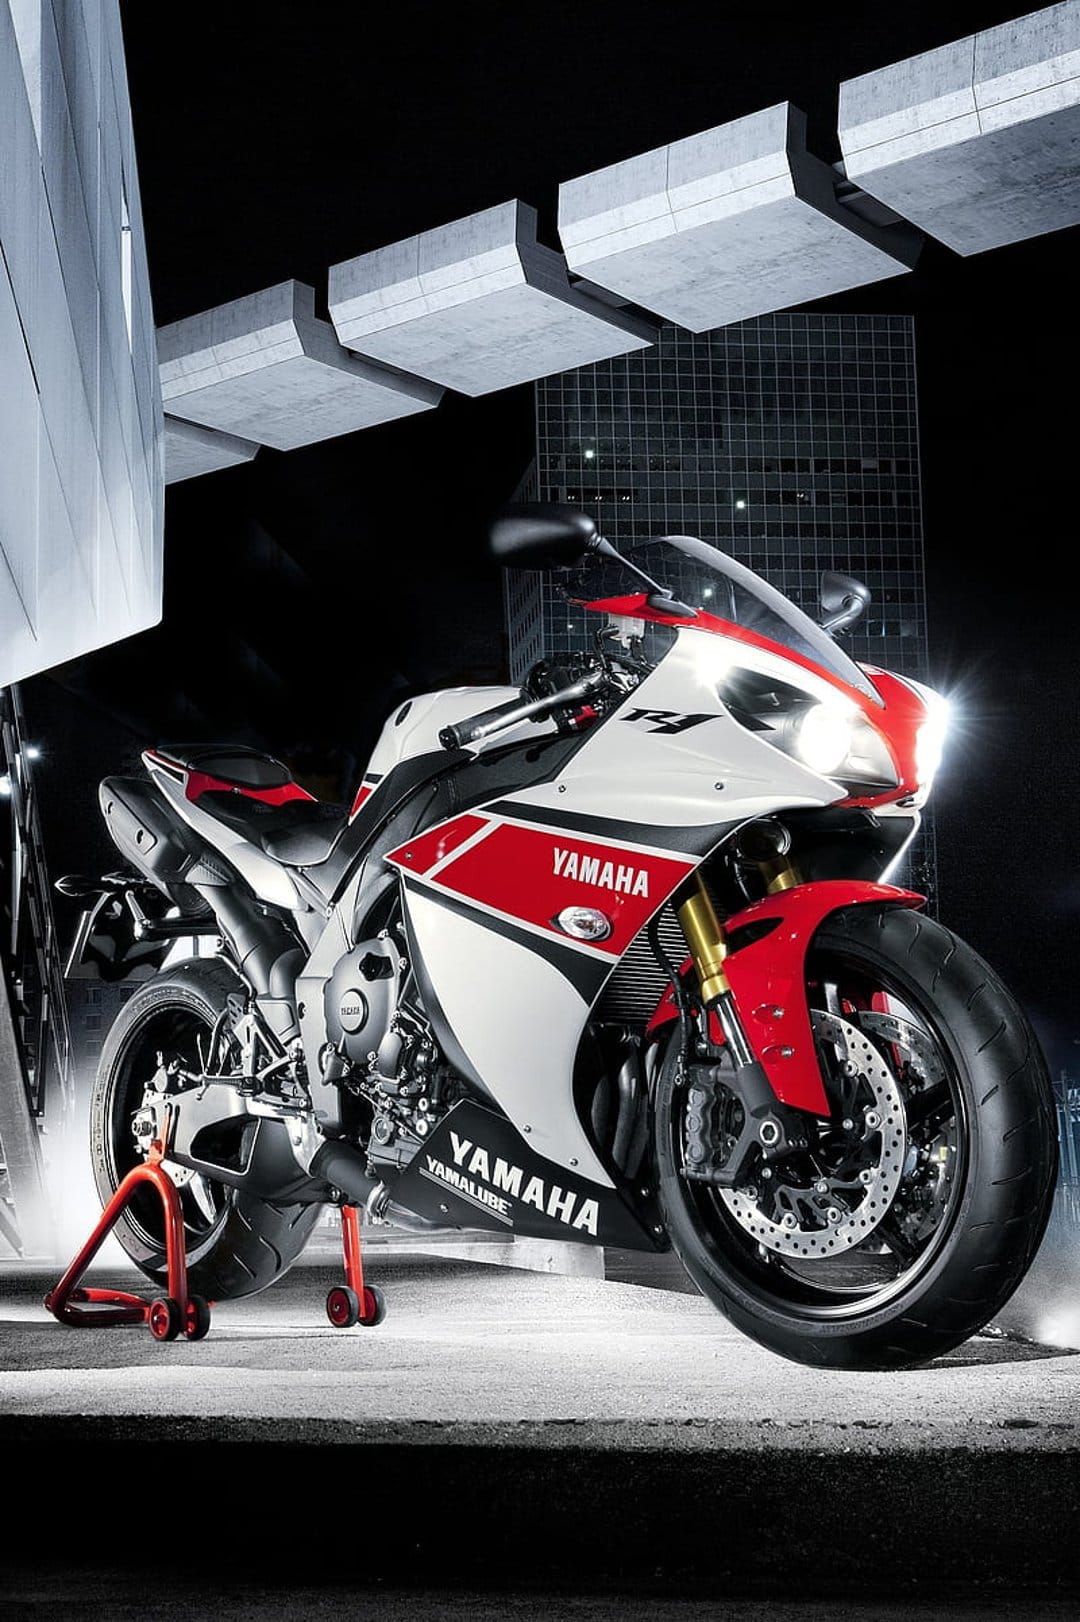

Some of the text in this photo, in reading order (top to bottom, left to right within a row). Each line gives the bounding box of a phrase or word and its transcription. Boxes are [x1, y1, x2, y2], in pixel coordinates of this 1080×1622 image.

[619, 708, 724, 734] R1
[553, 847, 649, 898] YAMAHA
[426, 1154, 509, 1215] YAMALUBE
[450, 1131, 599, 1236] YAMAHA
